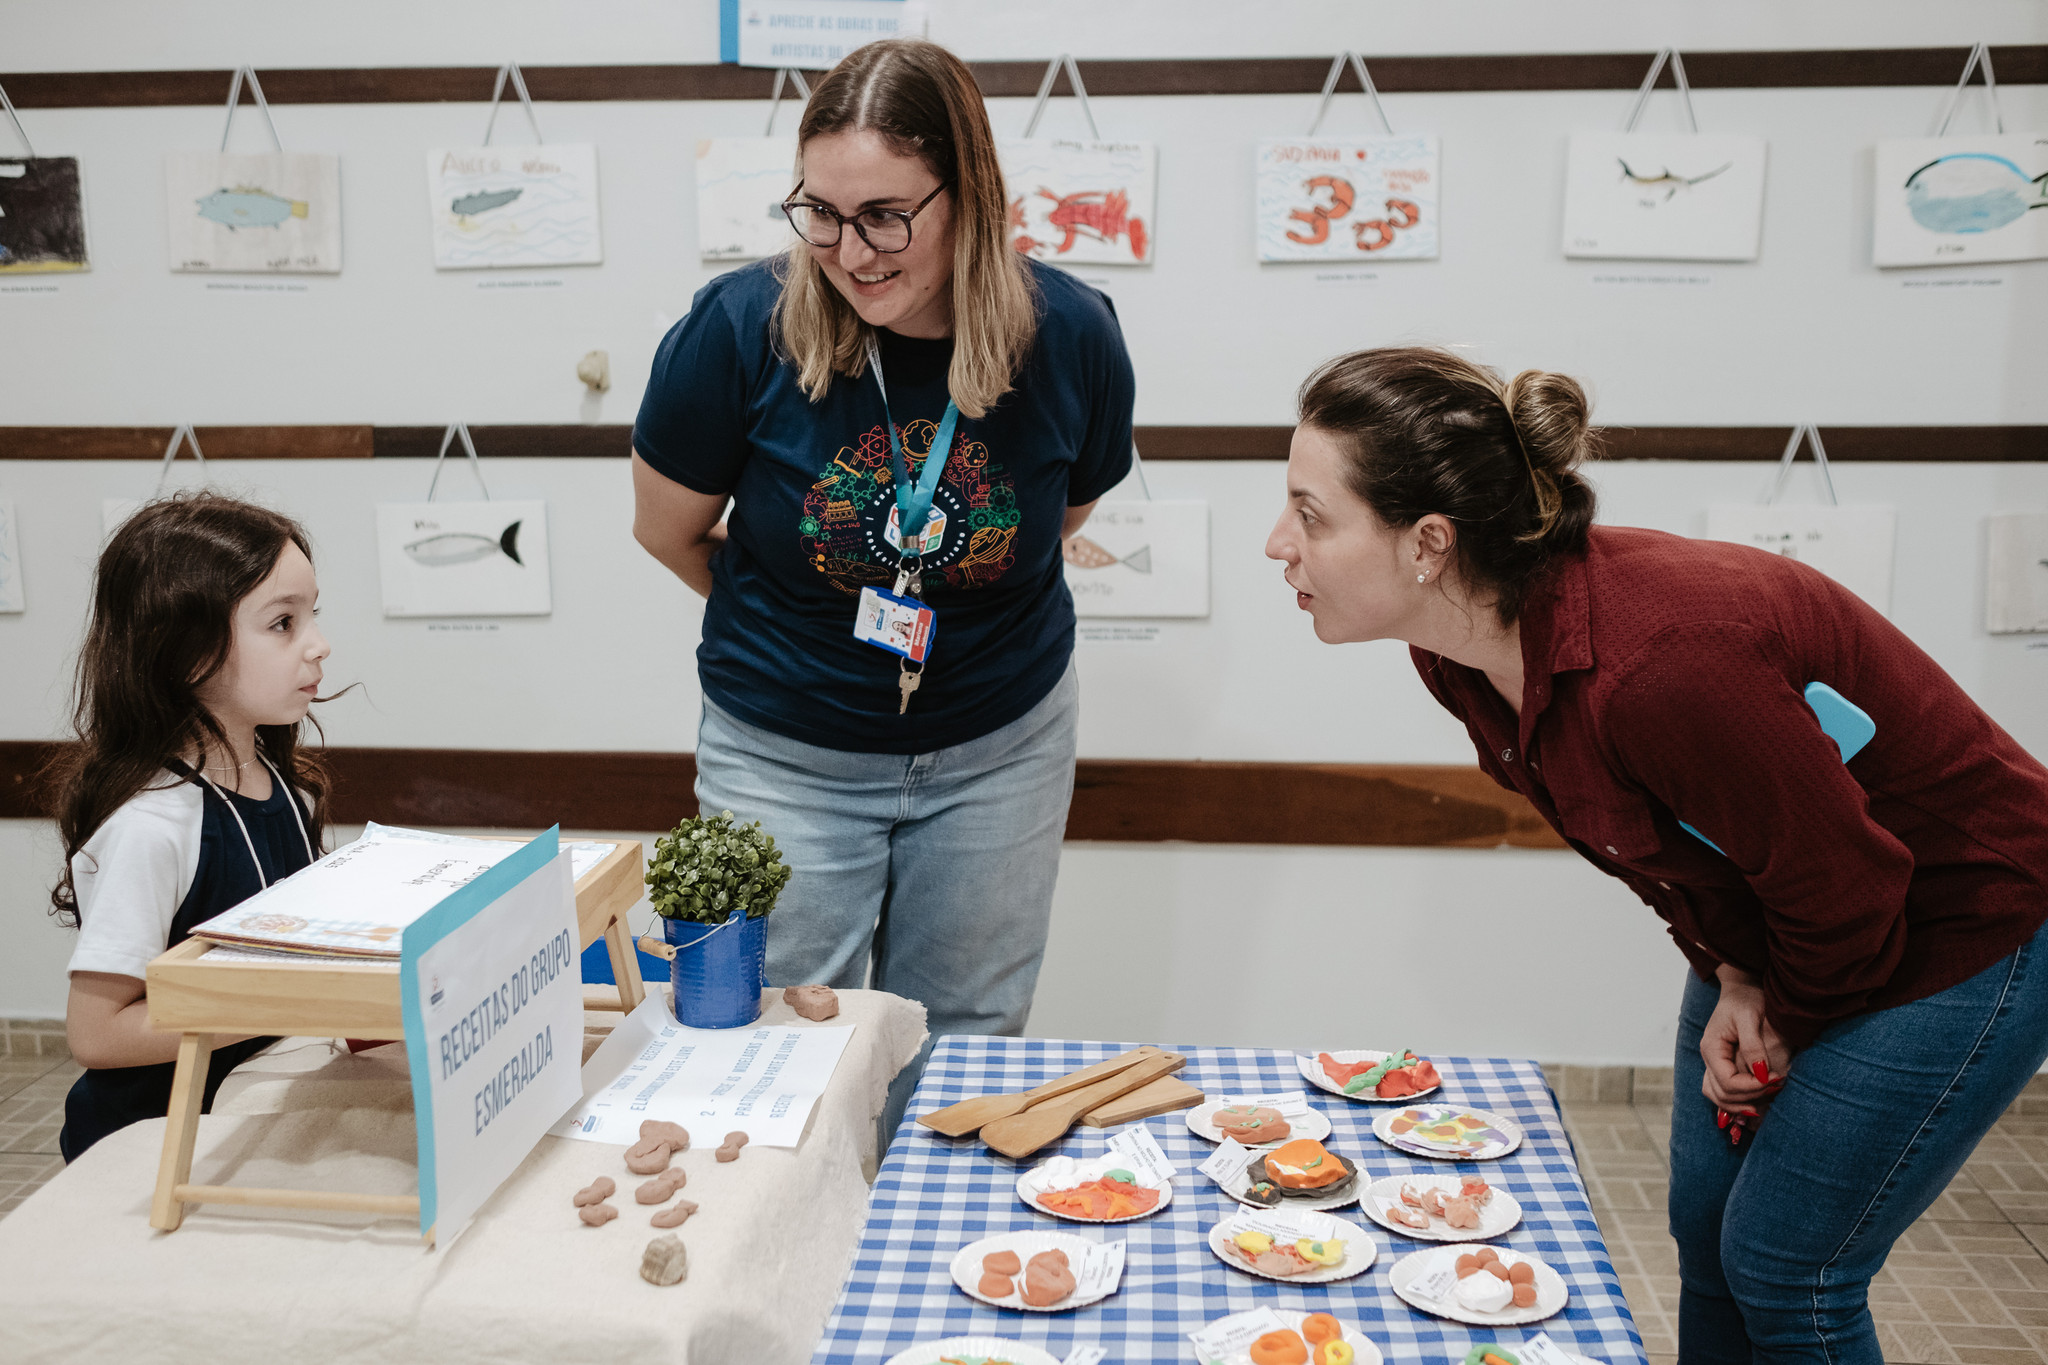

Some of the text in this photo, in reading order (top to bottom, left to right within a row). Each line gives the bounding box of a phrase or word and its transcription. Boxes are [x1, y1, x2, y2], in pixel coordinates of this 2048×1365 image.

[819, 16, 833, 30] AS
[771, 43, 823, 58] ARTISTAS
[440, 927, 571, 1081] RECEITAS DO GRUPO
[665, 1059, 686, 1071] ESTE
[764, 1060, 785, 1075] PARTE
[778, 1039, 797, 1052] LIVRO
[474, 1024, 553, 1138] ESMERALDA
